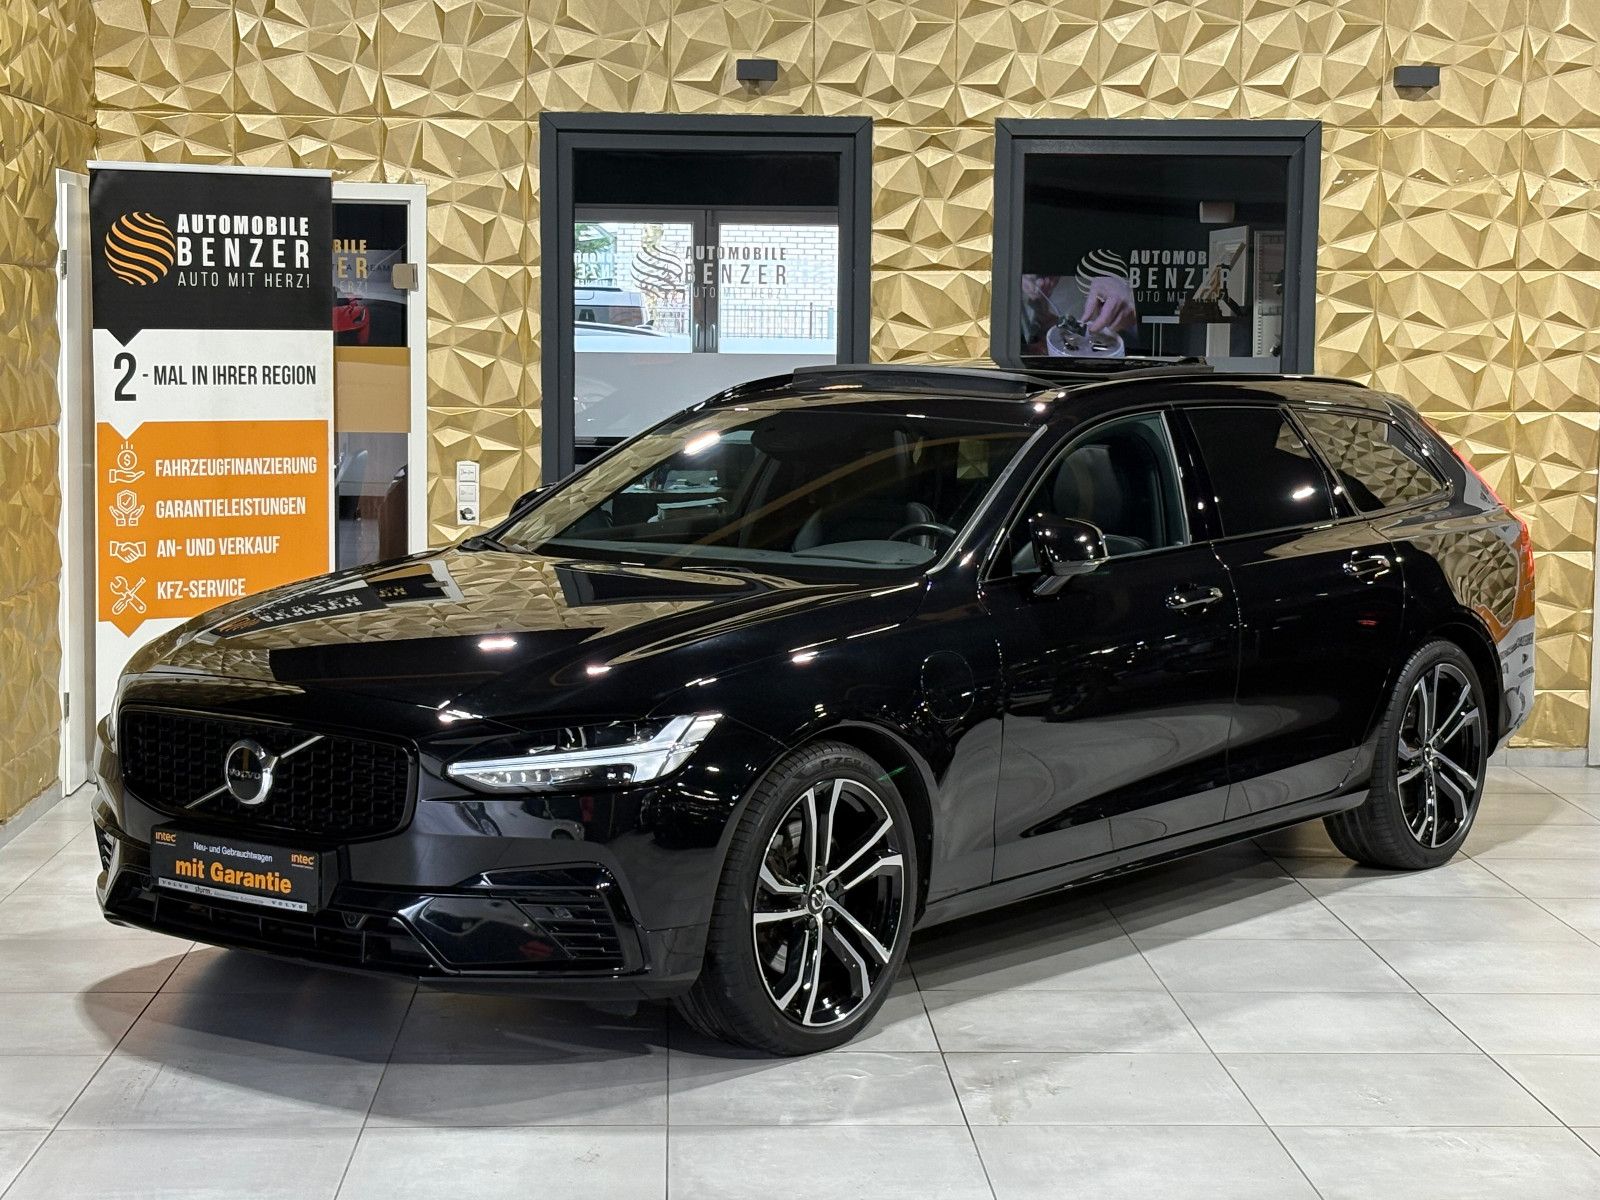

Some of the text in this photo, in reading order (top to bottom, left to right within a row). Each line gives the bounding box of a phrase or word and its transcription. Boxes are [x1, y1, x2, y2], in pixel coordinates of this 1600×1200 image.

[177, 213, 309, 237] AUTOMOBILE
[178, 236, 310, 269] BENZER
[684, 245, 787, 261] AUTOMOBILE
[1129, 249, 1208, 265] AUTOMOB
[178, 271, 311, 289] AUTO MIT HERZ!
[684, 262, 787, 285] BENZER
[686, 286, 716, 298] UTO
[1132, 290, 1160, 303] UTO
[113, 352, 138, 401] 2
[153, 365, 188, 386] MAL
[192, 365, 208, 385] IN
[212, 365, 257, 385] IHRER
[261, 364, 317, 385] REGION
[155, 456, 318, 478] FAHRZEUGFINANZIERUNG
[155, 496, 307, 519] GARANTIELEISTUNGEN
[156, 535, 281, 558] AN- UND VERKAUF
[157, 577, 247, 600] KFZ-SERVICE
[193, 841, 273, 863] Neu- und Gebrauchtwagen
[291, 853, 315, 866] intec
[175, 857, 292, 894] mit Garantie
